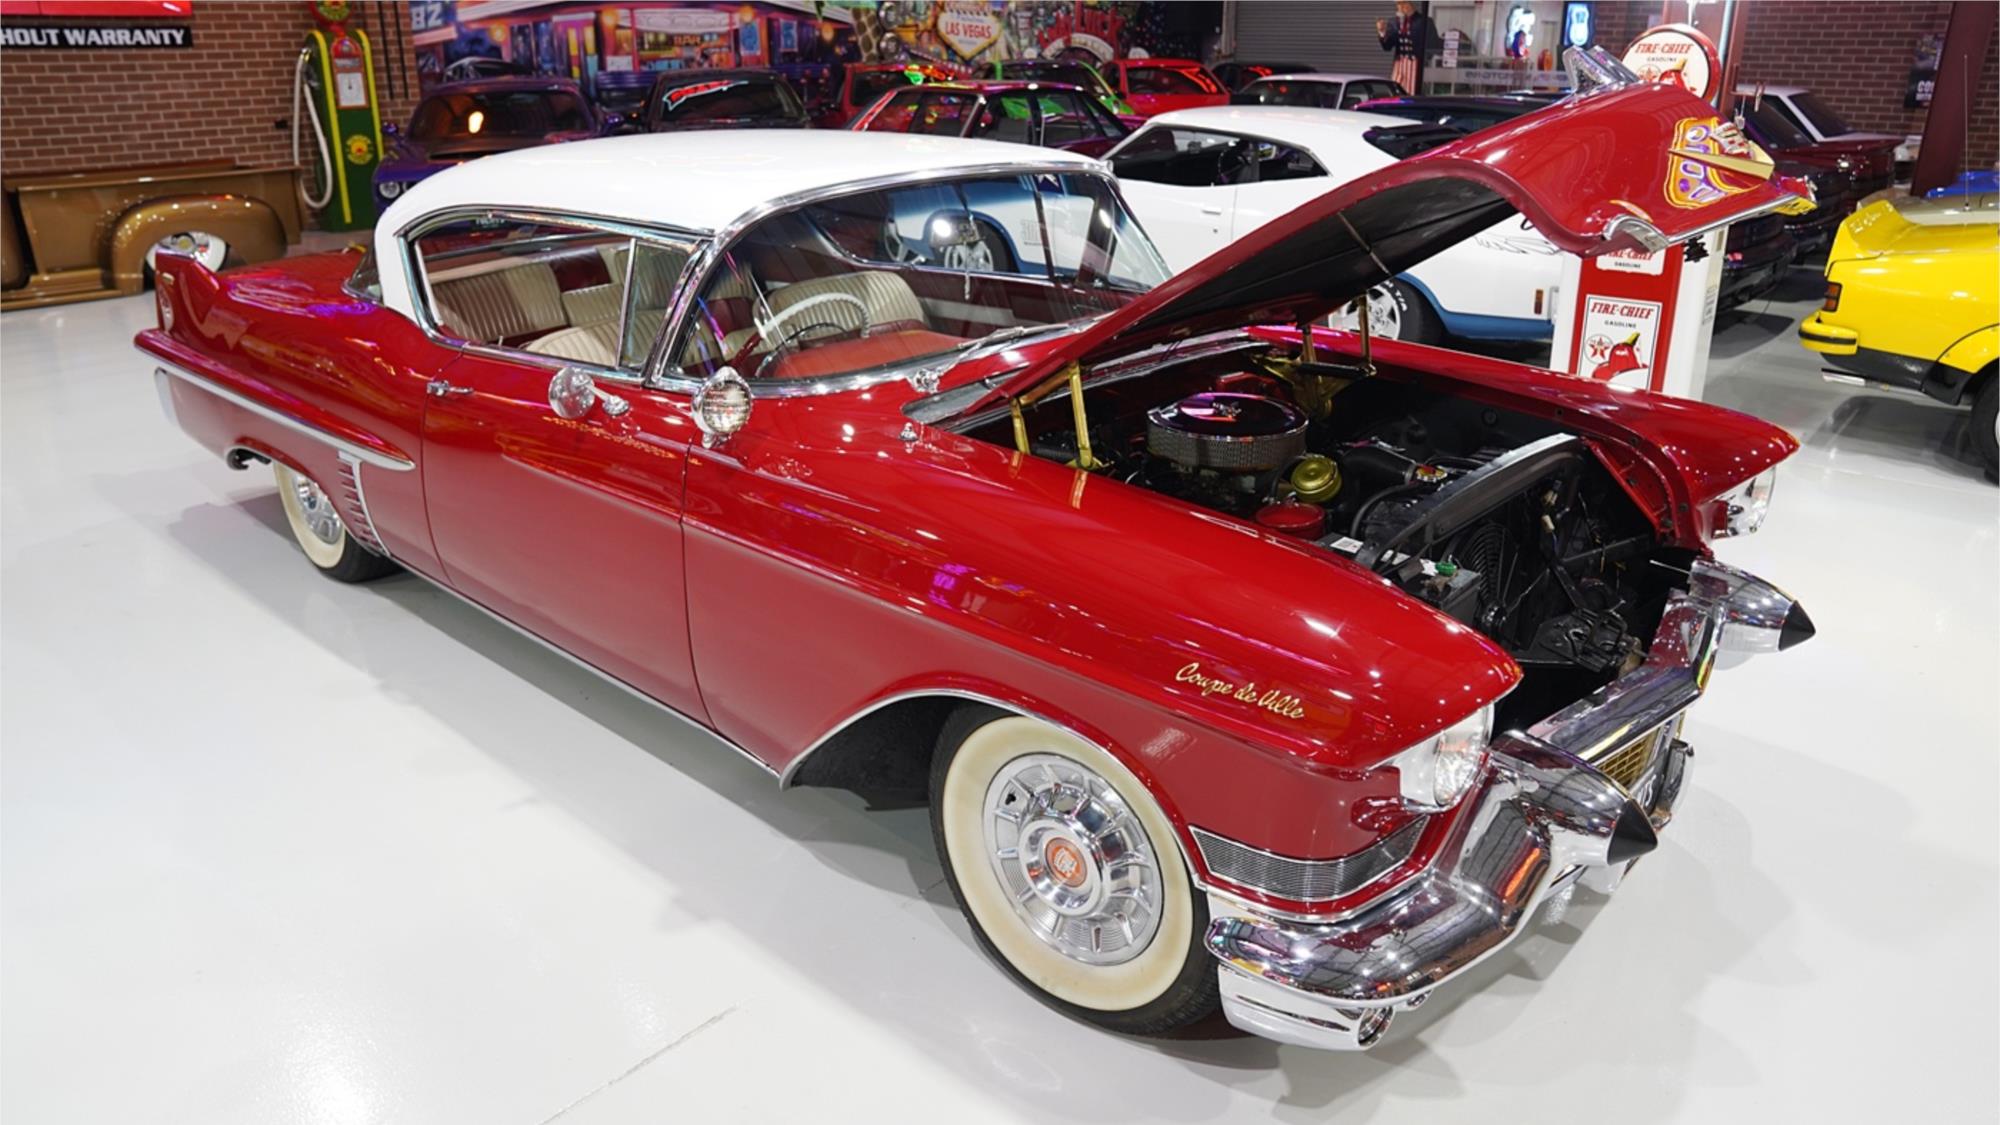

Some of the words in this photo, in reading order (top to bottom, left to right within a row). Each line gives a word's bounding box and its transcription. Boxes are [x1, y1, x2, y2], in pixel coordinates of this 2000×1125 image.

[0, 28, 60, 46] HOUT
[63, 28, 185, 46] WARRANTY
[945, 21, 960, 36] LAS
[962, 22, 992, 39] VEGAS
[1634, 42, 1695, 54] FIRE-CHIEF
[1591, 302, 1655, 319] FIRE-CHIEF
[1604, 320, 1637, 328] GASOLINE
[1175, 662, 1234, 697] Coupe
[1233, 682, 1258, 703] de
[1257, 690, 1305, 719] Ville
